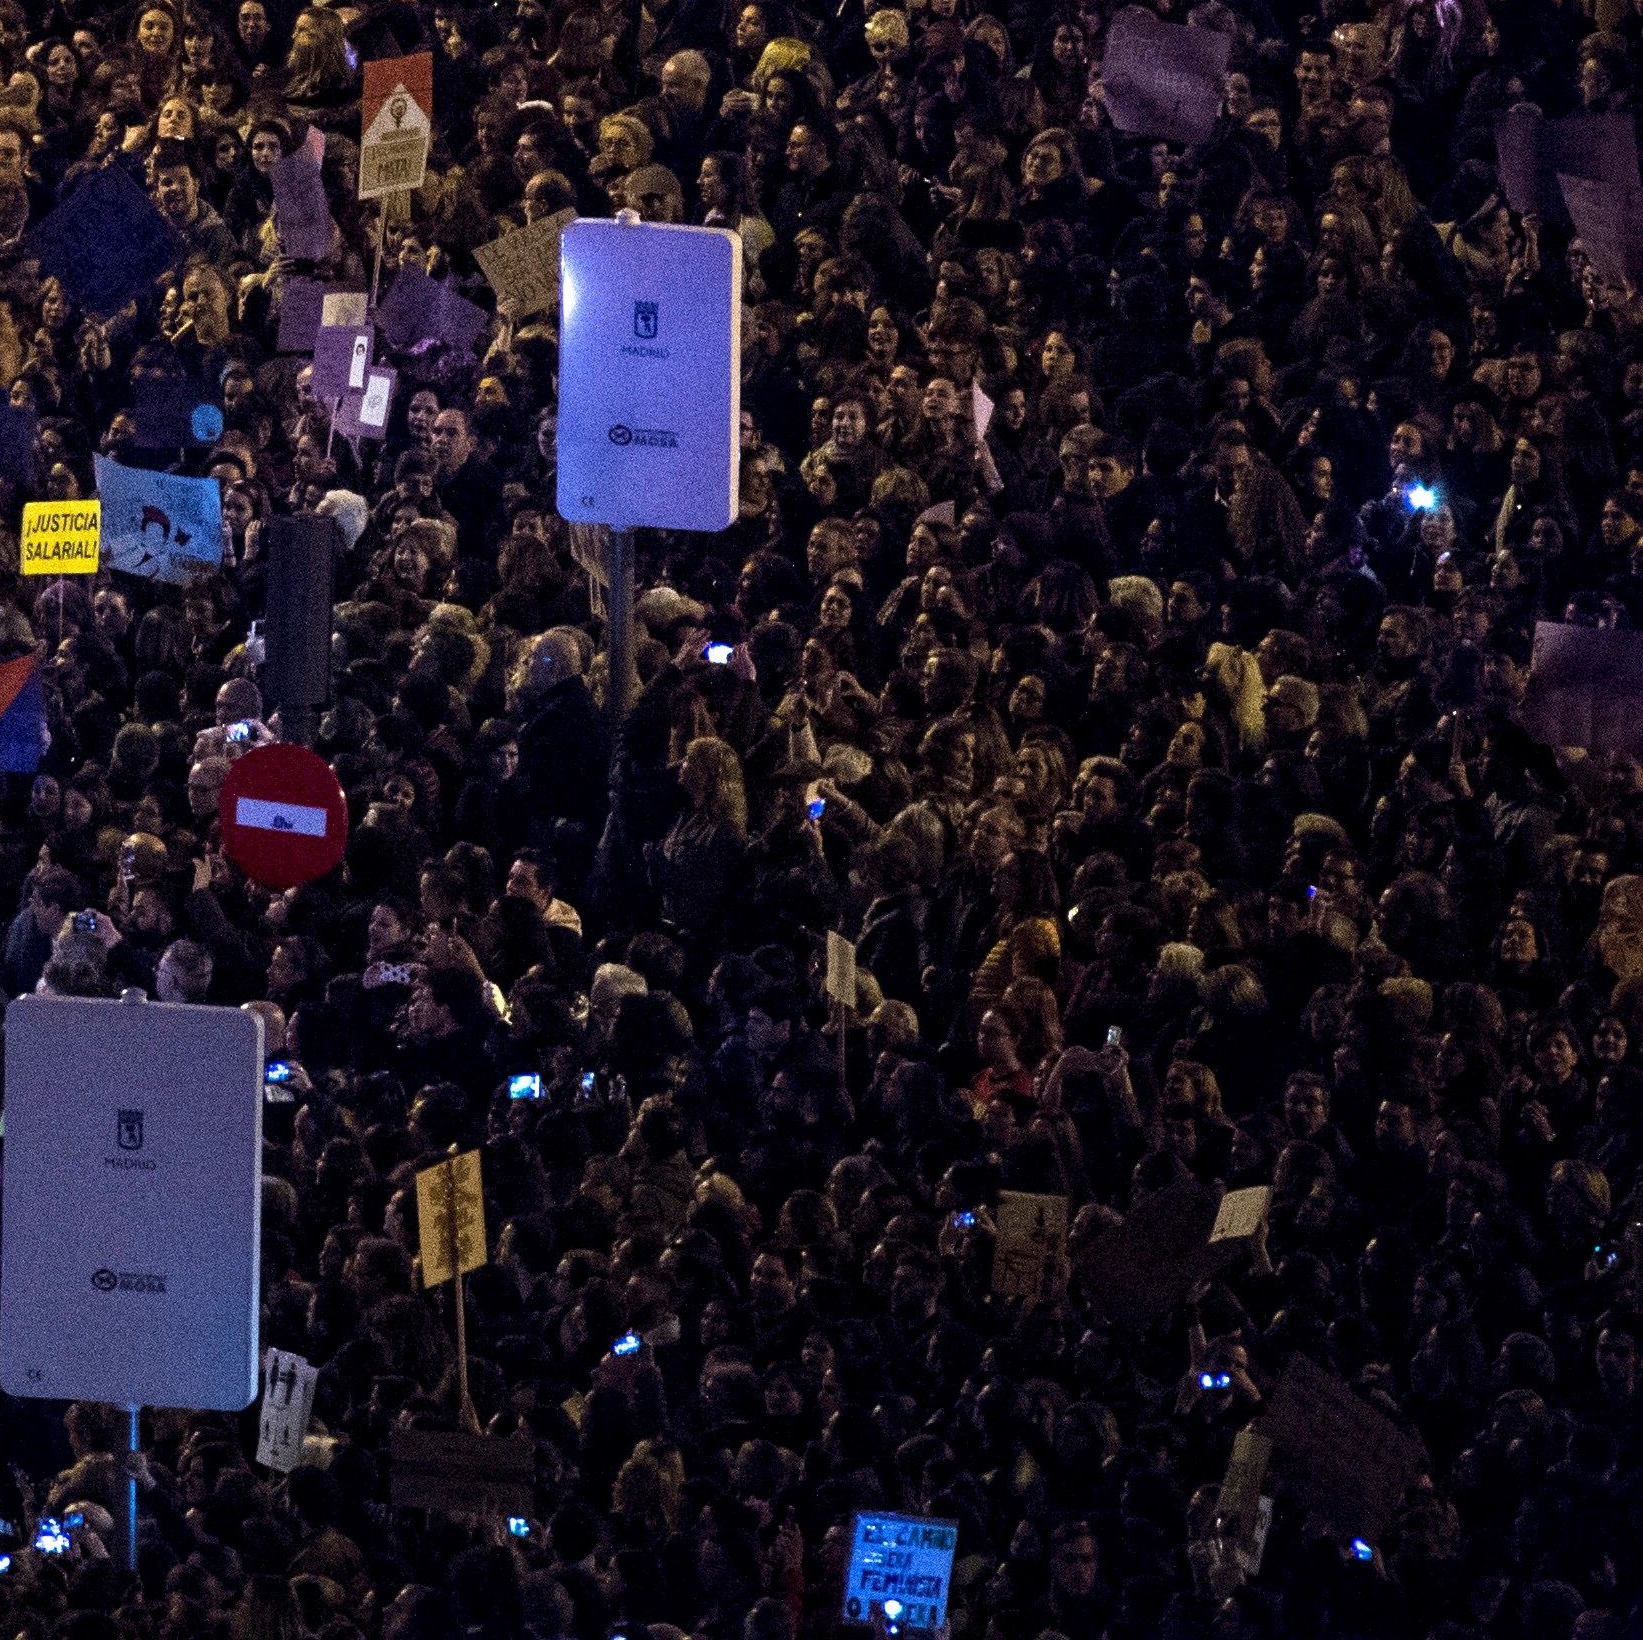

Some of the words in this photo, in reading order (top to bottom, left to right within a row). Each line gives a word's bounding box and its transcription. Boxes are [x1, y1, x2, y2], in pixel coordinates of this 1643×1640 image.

[621, 346, 670, 358] MADRID
[30, 512, 97, 535] ¡JUSTICIA
[27, 540, 97, 561] SALARIAL!
[103, 1157, 157, 1171] MADRID
